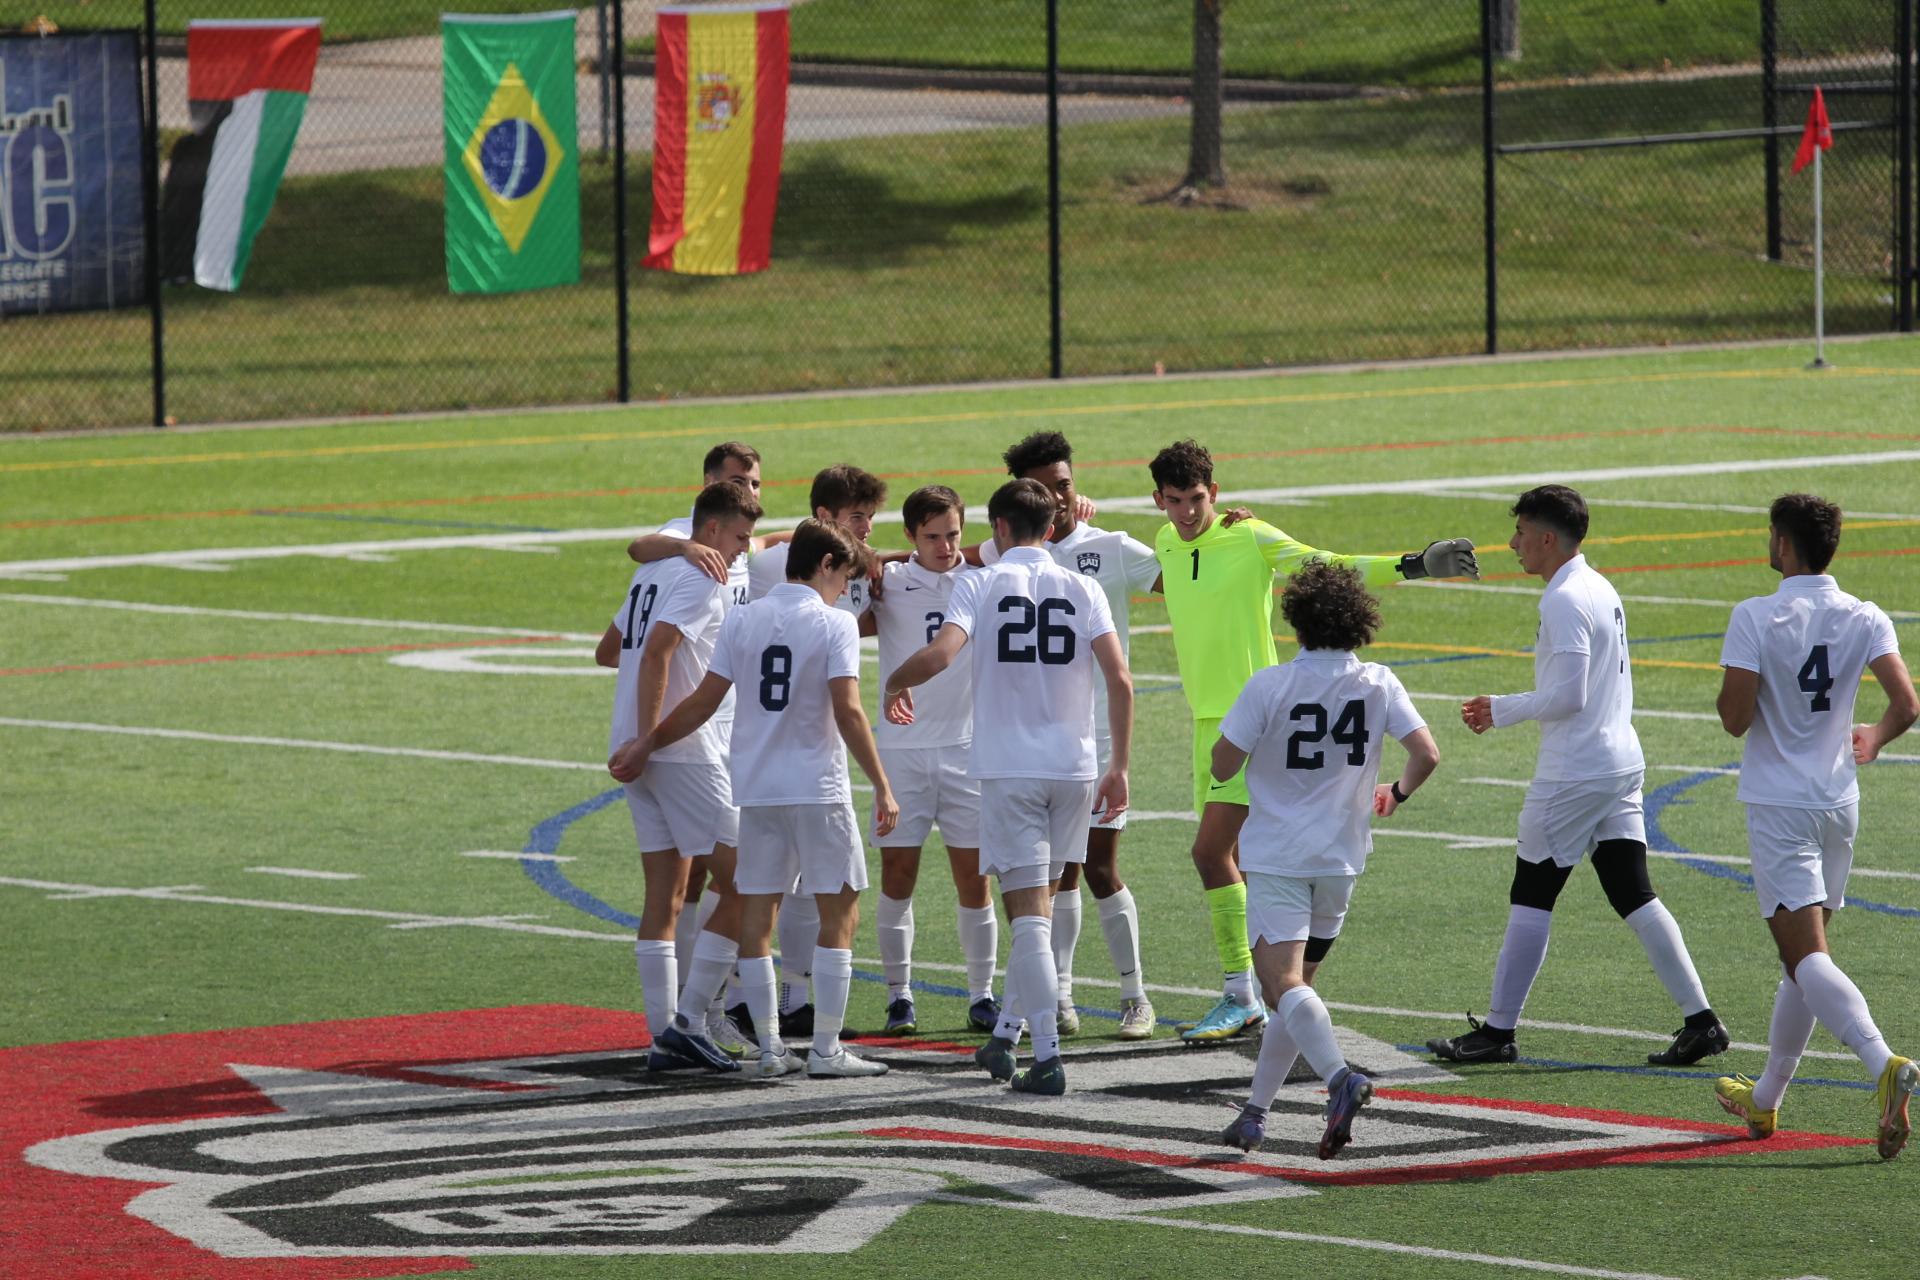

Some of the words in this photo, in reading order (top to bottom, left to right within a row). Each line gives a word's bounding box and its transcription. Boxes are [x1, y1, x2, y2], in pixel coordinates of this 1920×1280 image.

[1080, 558, 1099, 568] SAU
[1191, 548, 1199, 580] 1
[622, 584, 658, 649] 18
[925, 611, 945, 645] 2
[998, 596, 1076, 665] 26
[760, 645, 792, 711] 8
[1797, 645, 1834, 713] 4
[1286, 699, 1369, 769] 24
